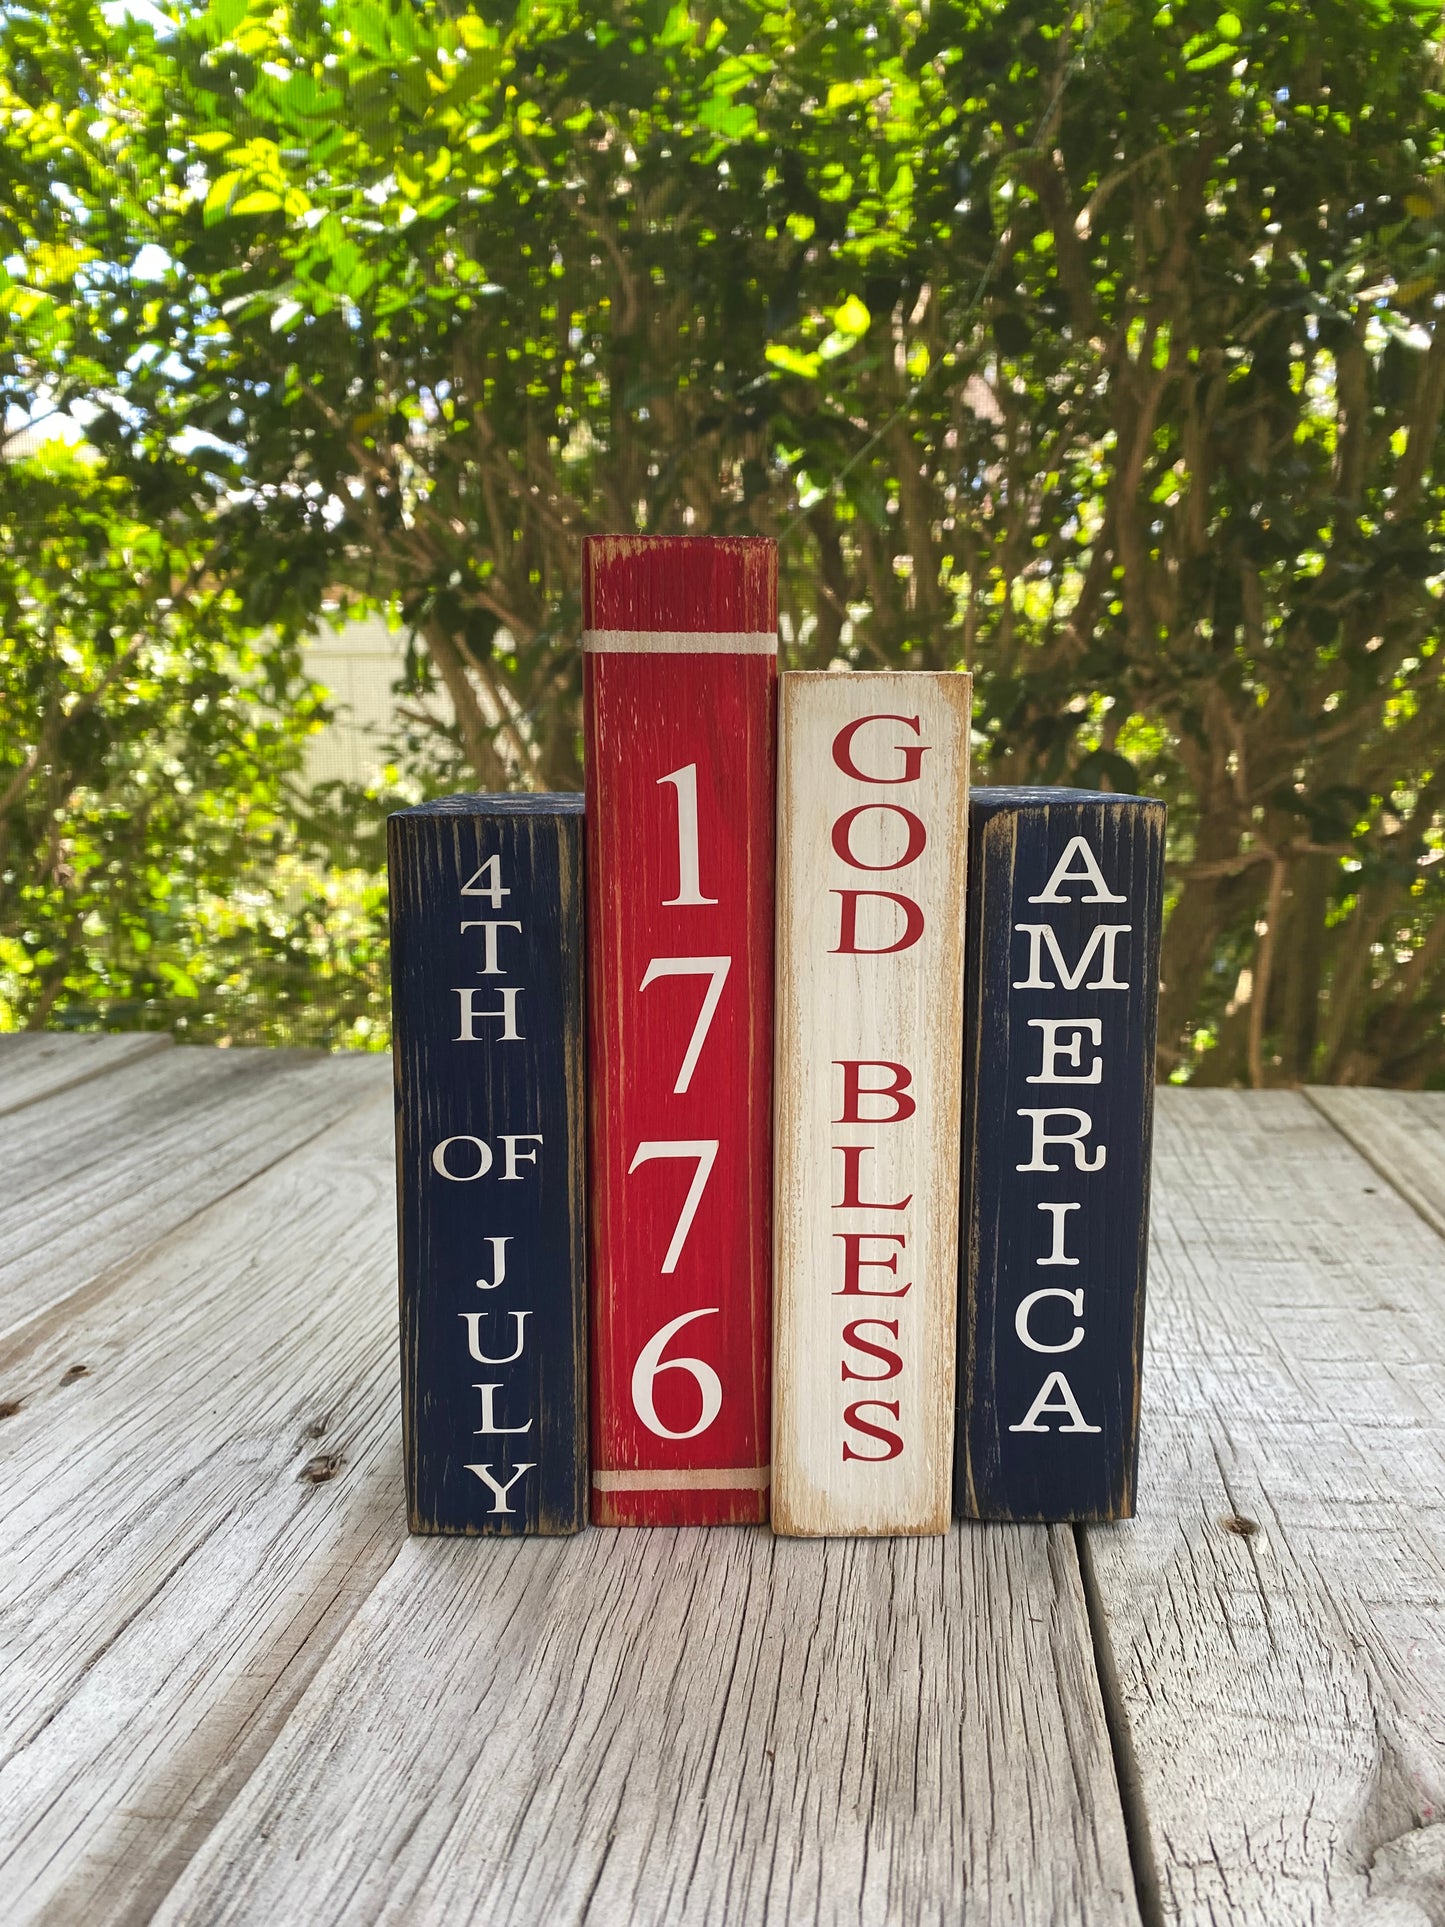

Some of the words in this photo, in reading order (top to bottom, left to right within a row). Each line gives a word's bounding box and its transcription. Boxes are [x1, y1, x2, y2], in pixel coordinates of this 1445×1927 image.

[451, 854, 527, 1042] 4TH
[827, 714, 931, 955] GOD
[432, 1134, 544, 1182] OF
[628, 762, 732, 1440] 1776
[1009, 835, 1133, 1433] AMERICA
[458, 1236, 537, 1514] JULY
[831, 1060, 916, 1462] BLESS
